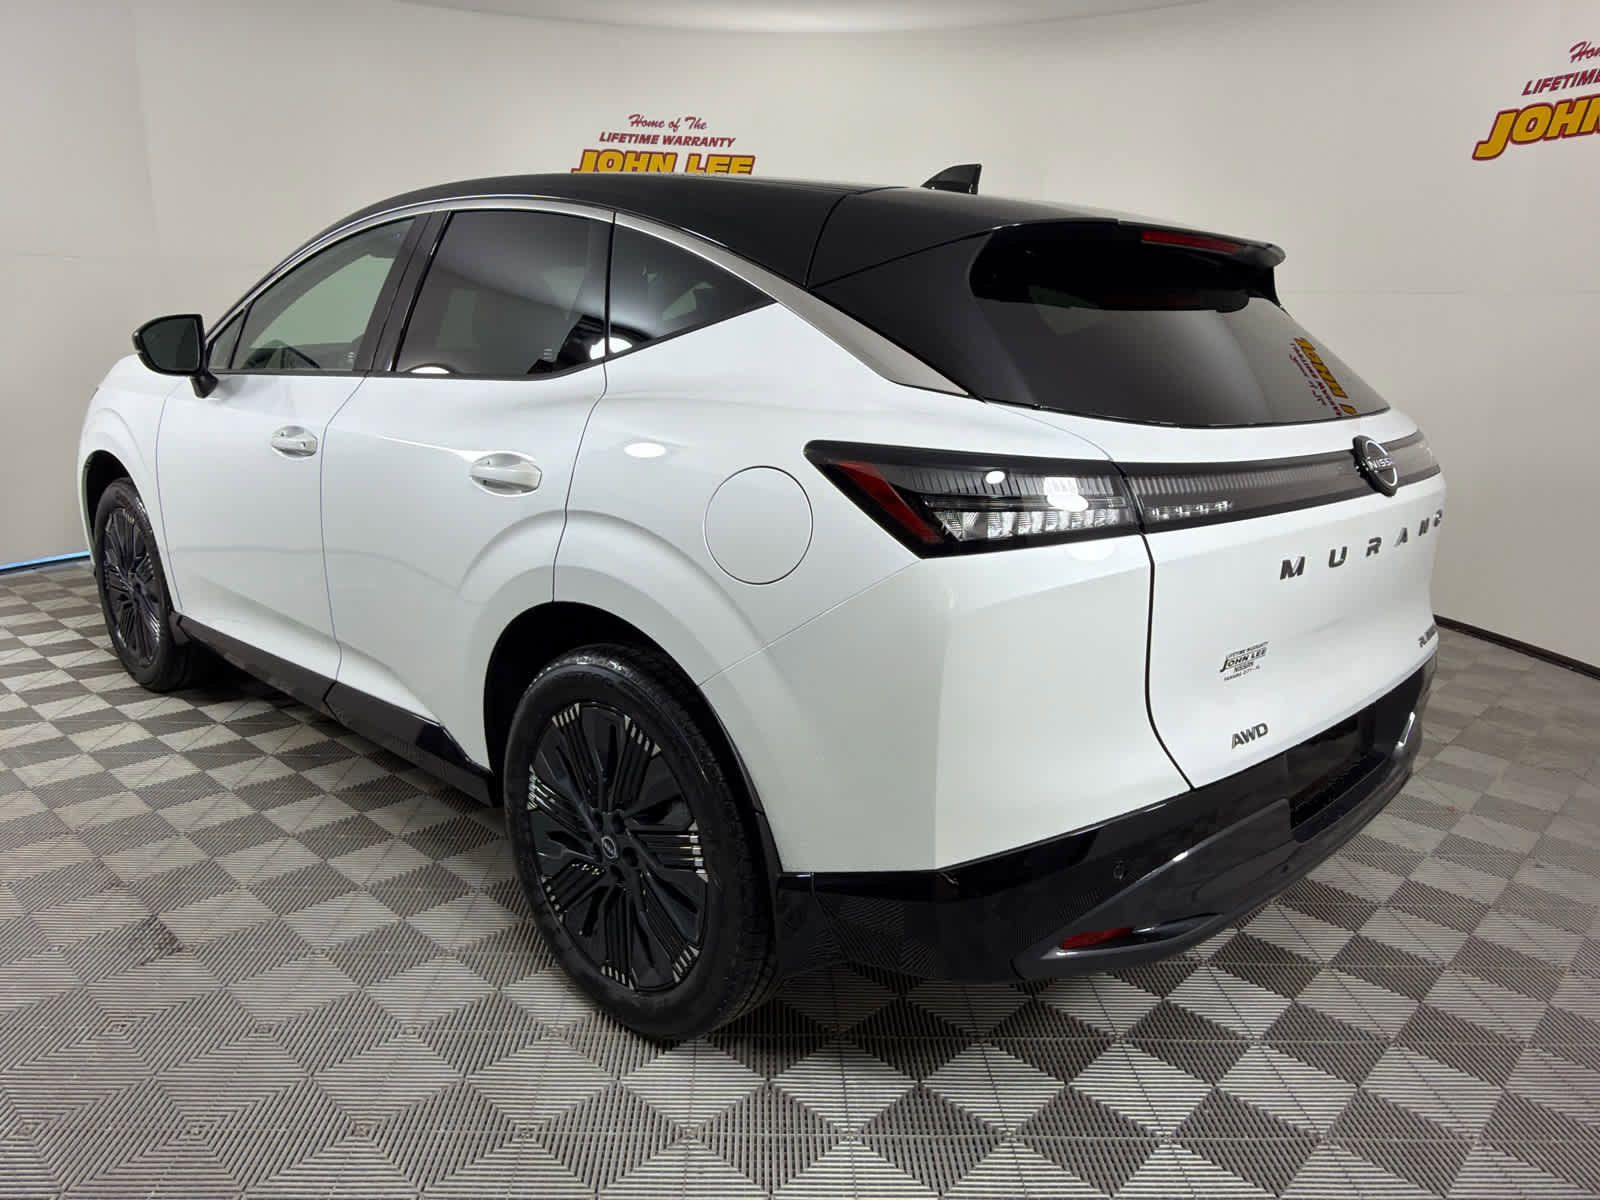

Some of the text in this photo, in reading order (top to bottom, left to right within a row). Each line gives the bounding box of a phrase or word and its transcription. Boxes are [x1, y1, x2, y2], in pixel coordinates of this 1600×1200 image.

[1569, 40, 1600, 63] Ho
[628, 113, 707, 132] Home of The
[599, 131, 736, 148] LIFETIME WARRANTY
[571, 149, 755, 175] JOHN LEE
[1219, 647, 1267, 672] JOHN LEE
[1231, 722, 1268, 749] AWD
